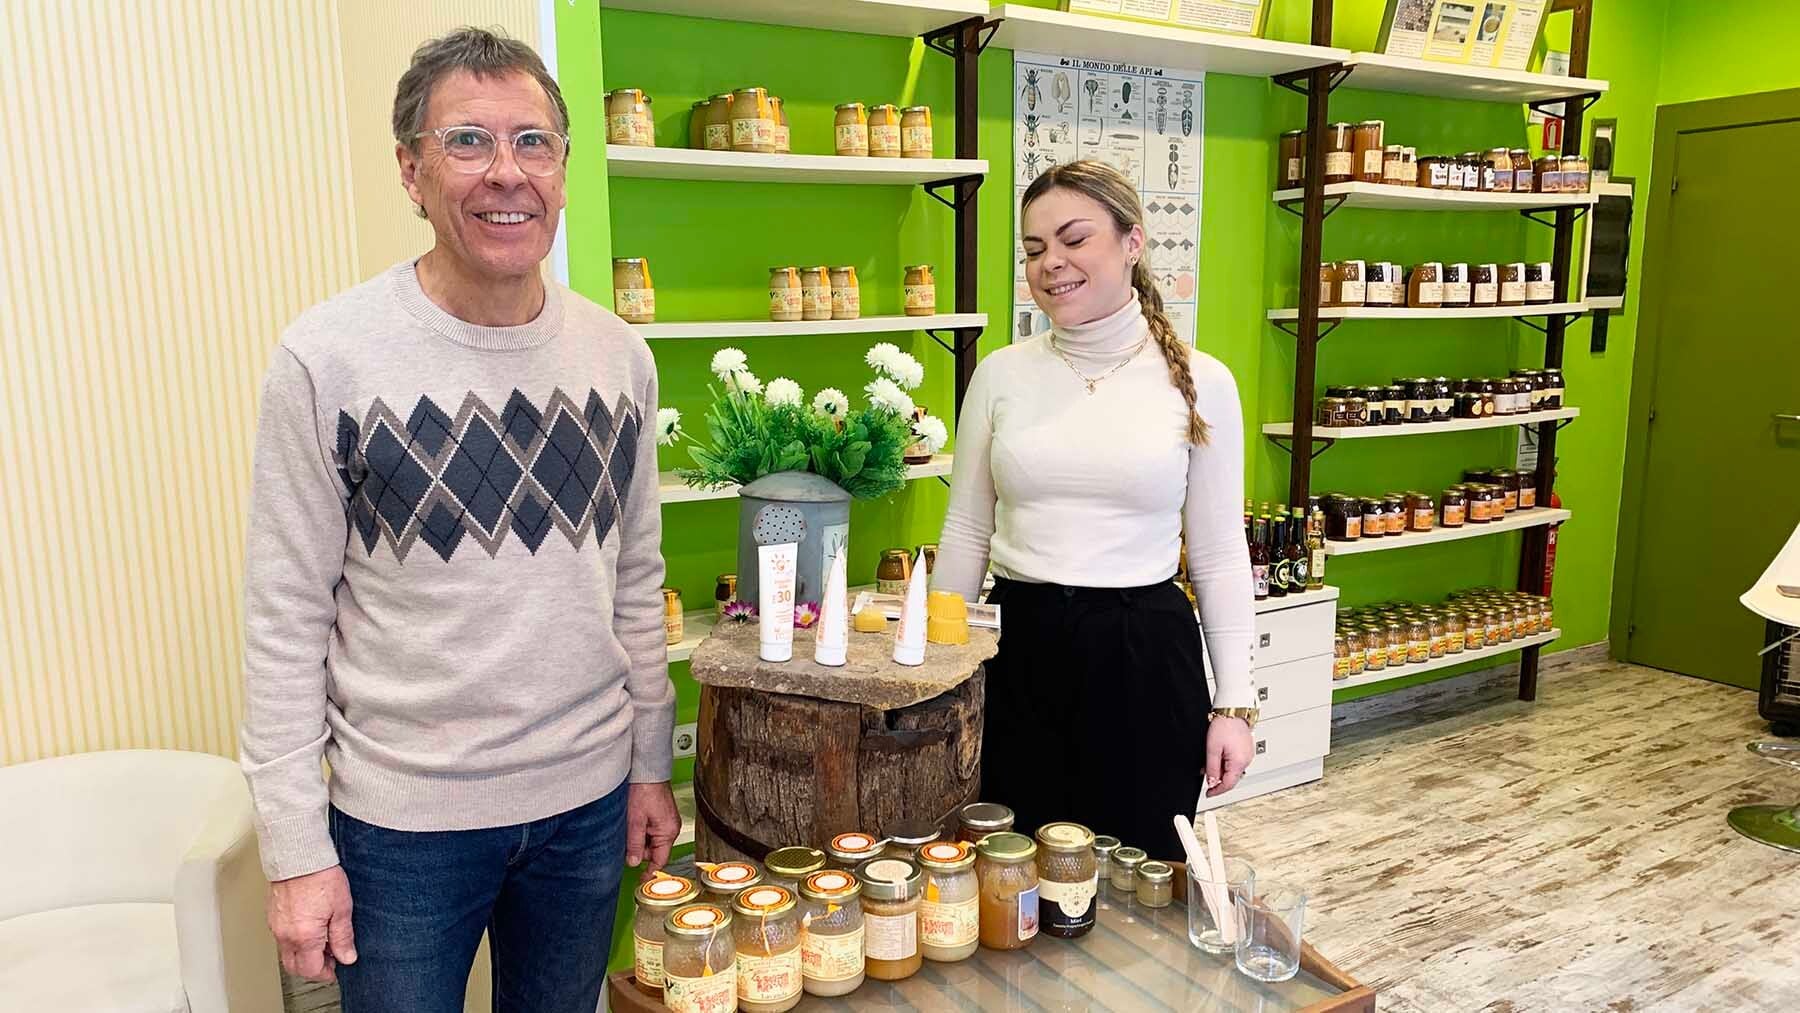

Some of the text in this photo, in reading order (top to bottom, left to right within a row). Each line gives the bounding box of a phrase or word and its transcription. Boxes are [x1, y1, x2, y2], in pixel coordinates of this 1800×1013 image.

[1072, 59, 1152, 75] IL MONDO DELLE API
[777, 590, 791, 603] 30
